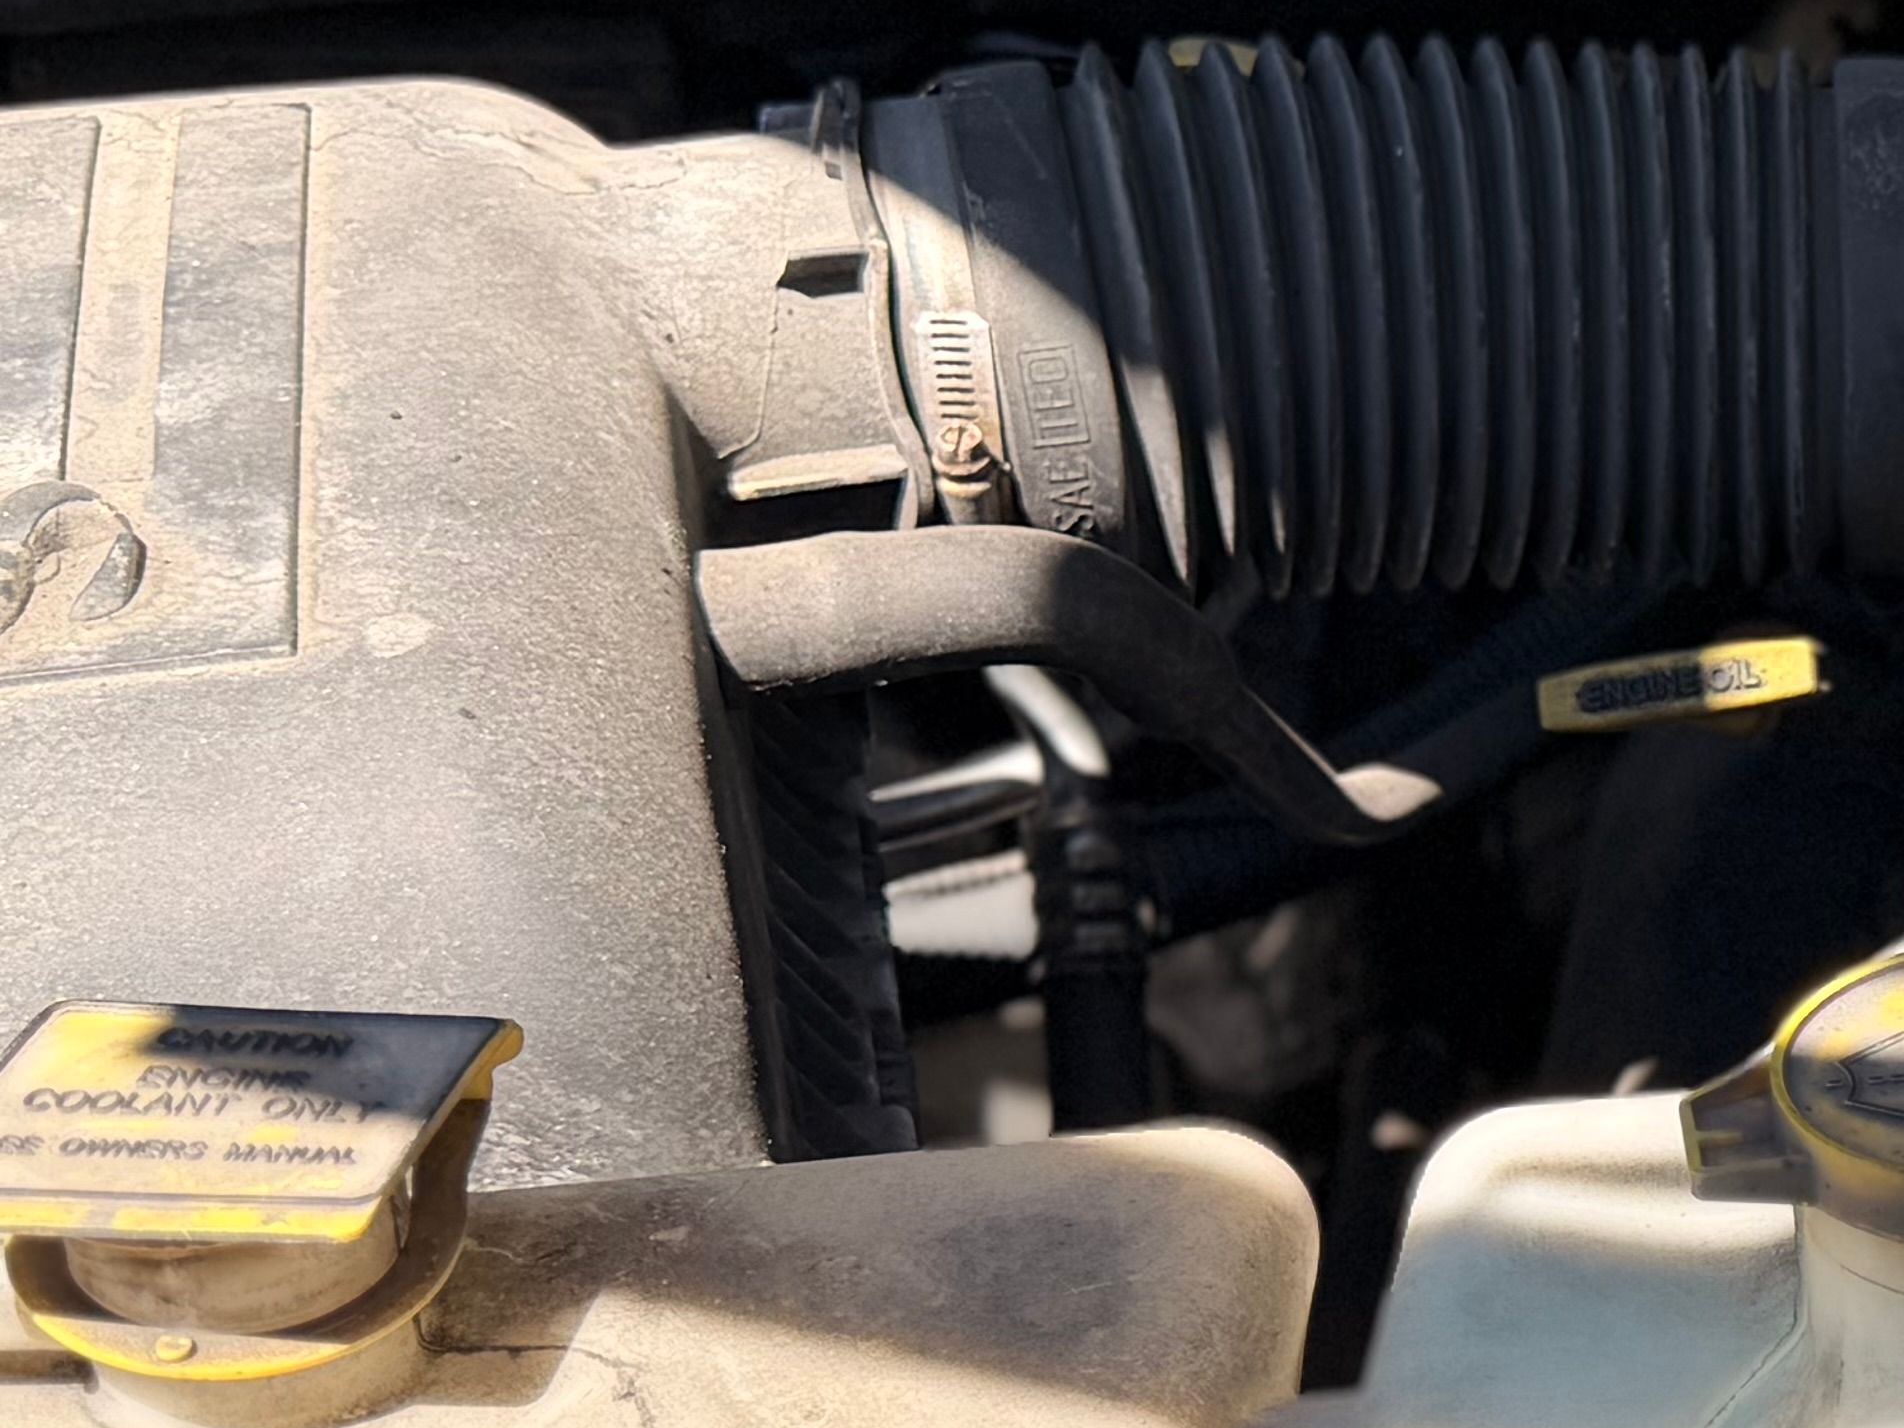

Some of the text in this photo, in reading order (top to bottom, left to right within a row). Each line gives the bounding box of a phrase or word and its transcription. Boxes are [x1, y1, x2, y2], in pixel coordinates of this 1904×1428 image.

[1050, 461, 1096, 536] SAE
[1576, 659, 1766, 713] ENGINE OIL
[155, 1026, 353, 1059] CAUTION
[136, 1064, 311, 1091] ENGINE
[23, 1087, 386, 1124] COOLANT ONLY
[0, 1133, 357, 1165] EE OWNERS MANUAL
